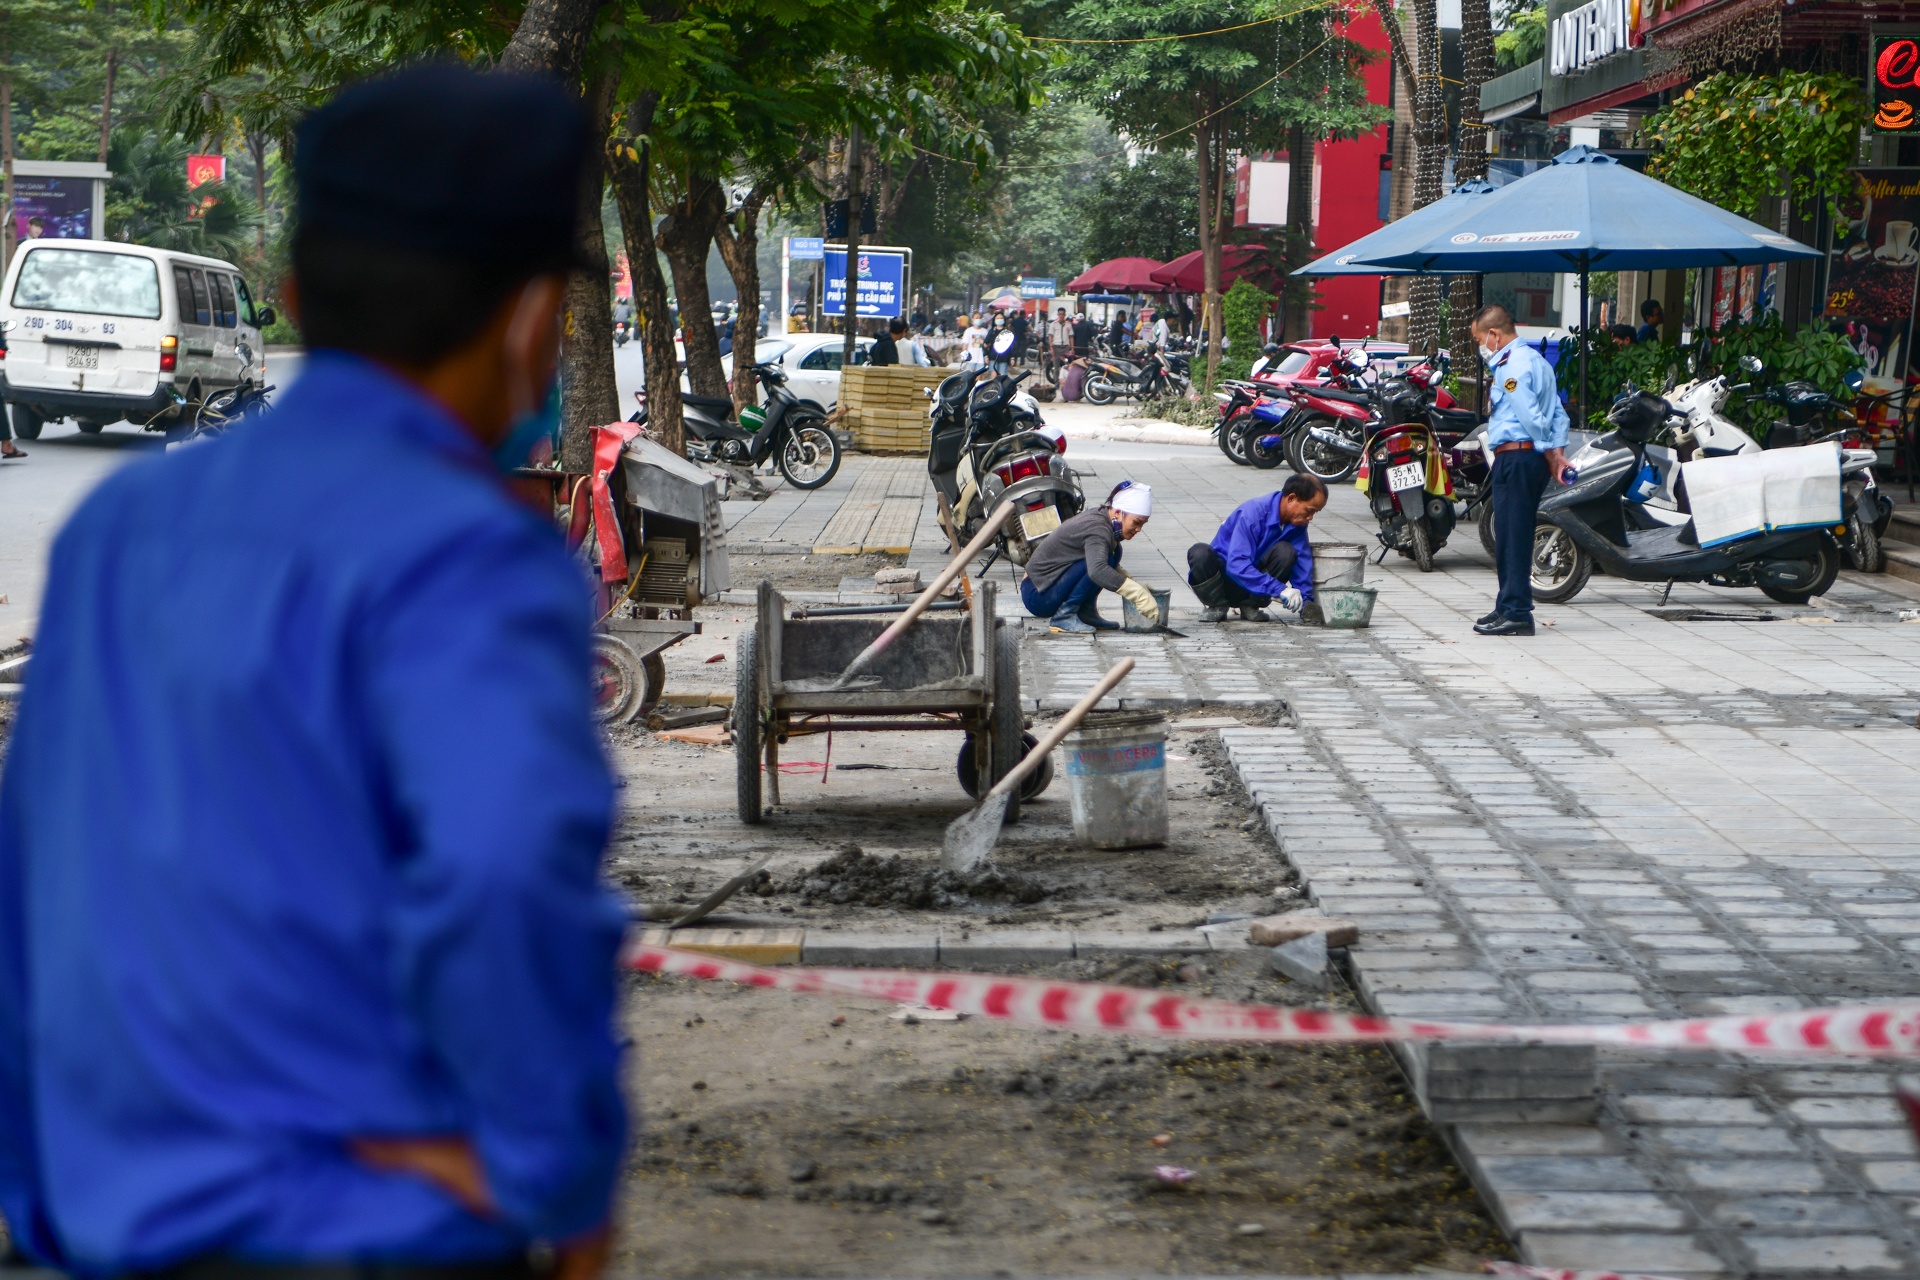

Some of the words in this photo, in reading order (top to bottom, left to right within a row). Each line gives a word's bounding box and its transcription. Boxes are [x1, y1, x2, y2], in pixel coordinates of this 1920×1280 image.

[1517, 231, 1575, 242] TRANG
[55, 319, 73, 331] 304
[102, 322, 116, 334] 93
